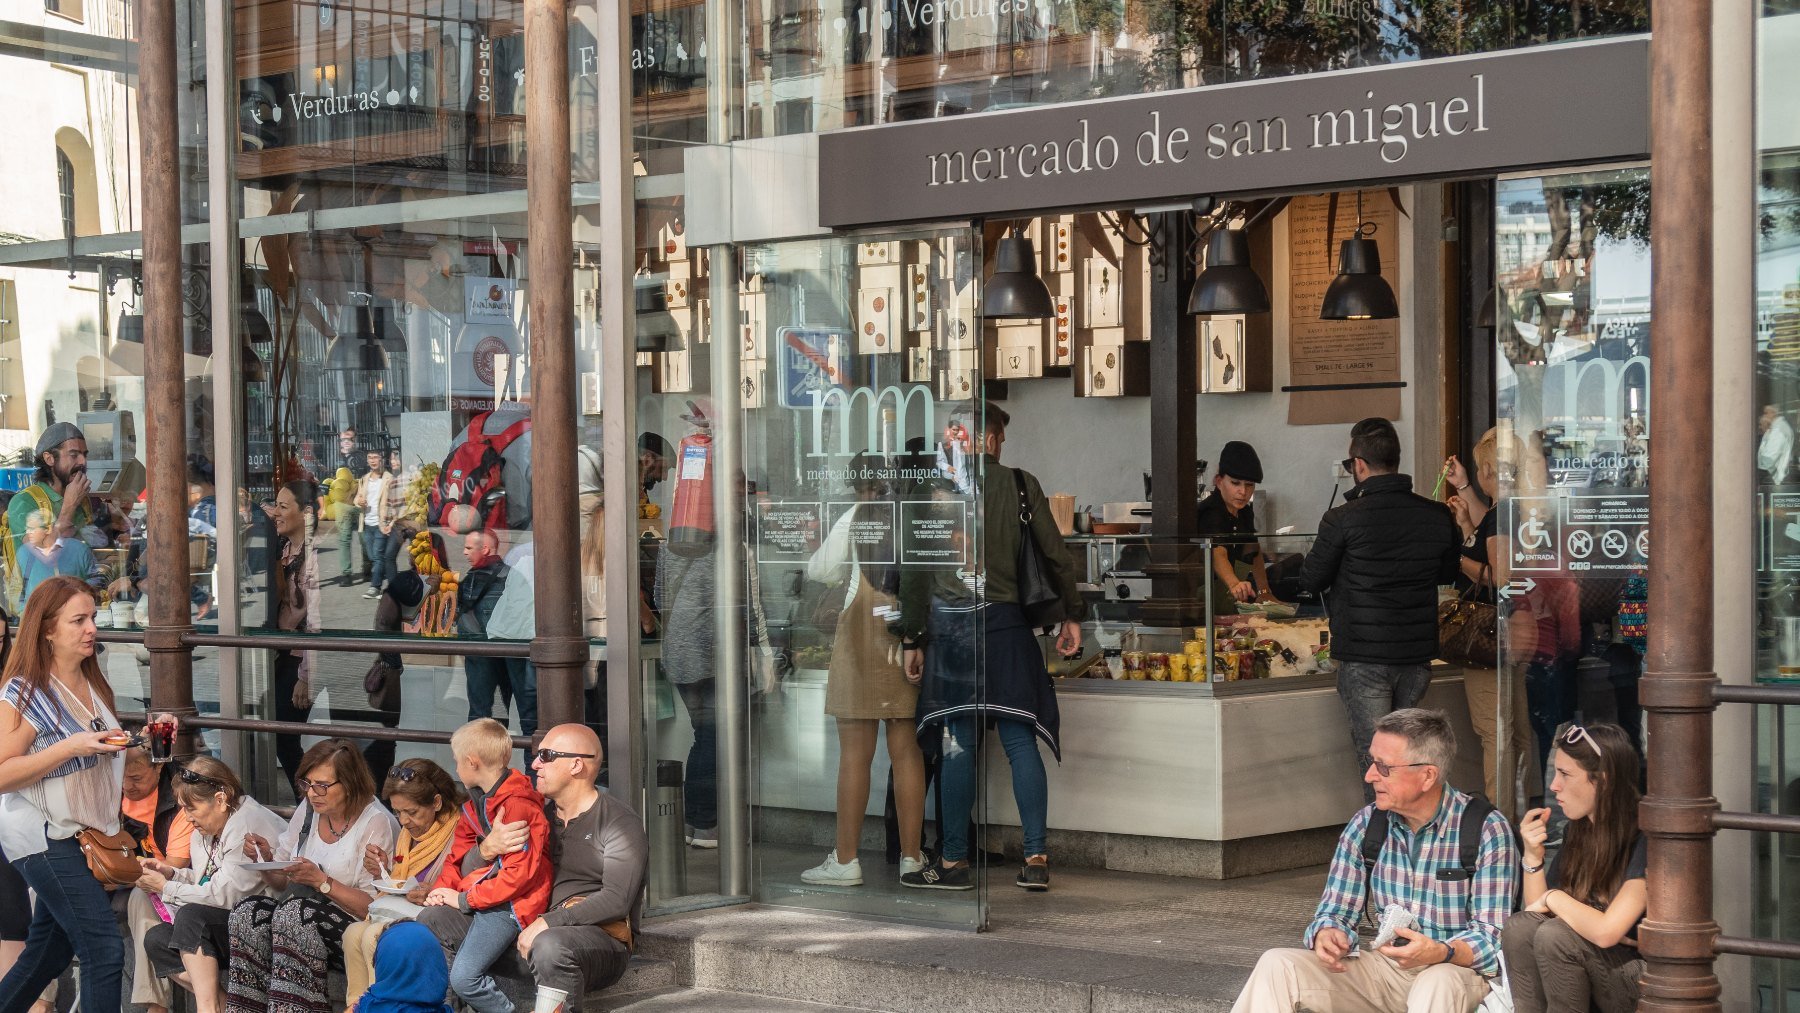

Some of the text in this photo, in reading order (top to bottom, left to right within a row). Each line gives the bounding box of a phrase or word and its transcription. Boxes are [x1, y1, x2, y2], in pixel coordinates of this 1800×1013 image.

[926, 73, 1490, 186] mercado de san miguel
[1554, 451, 1628, 470] mercado
[807, 464, 942, 485] mercado de san miguel
[1525, 553, 1555, 561] ENTRADA
